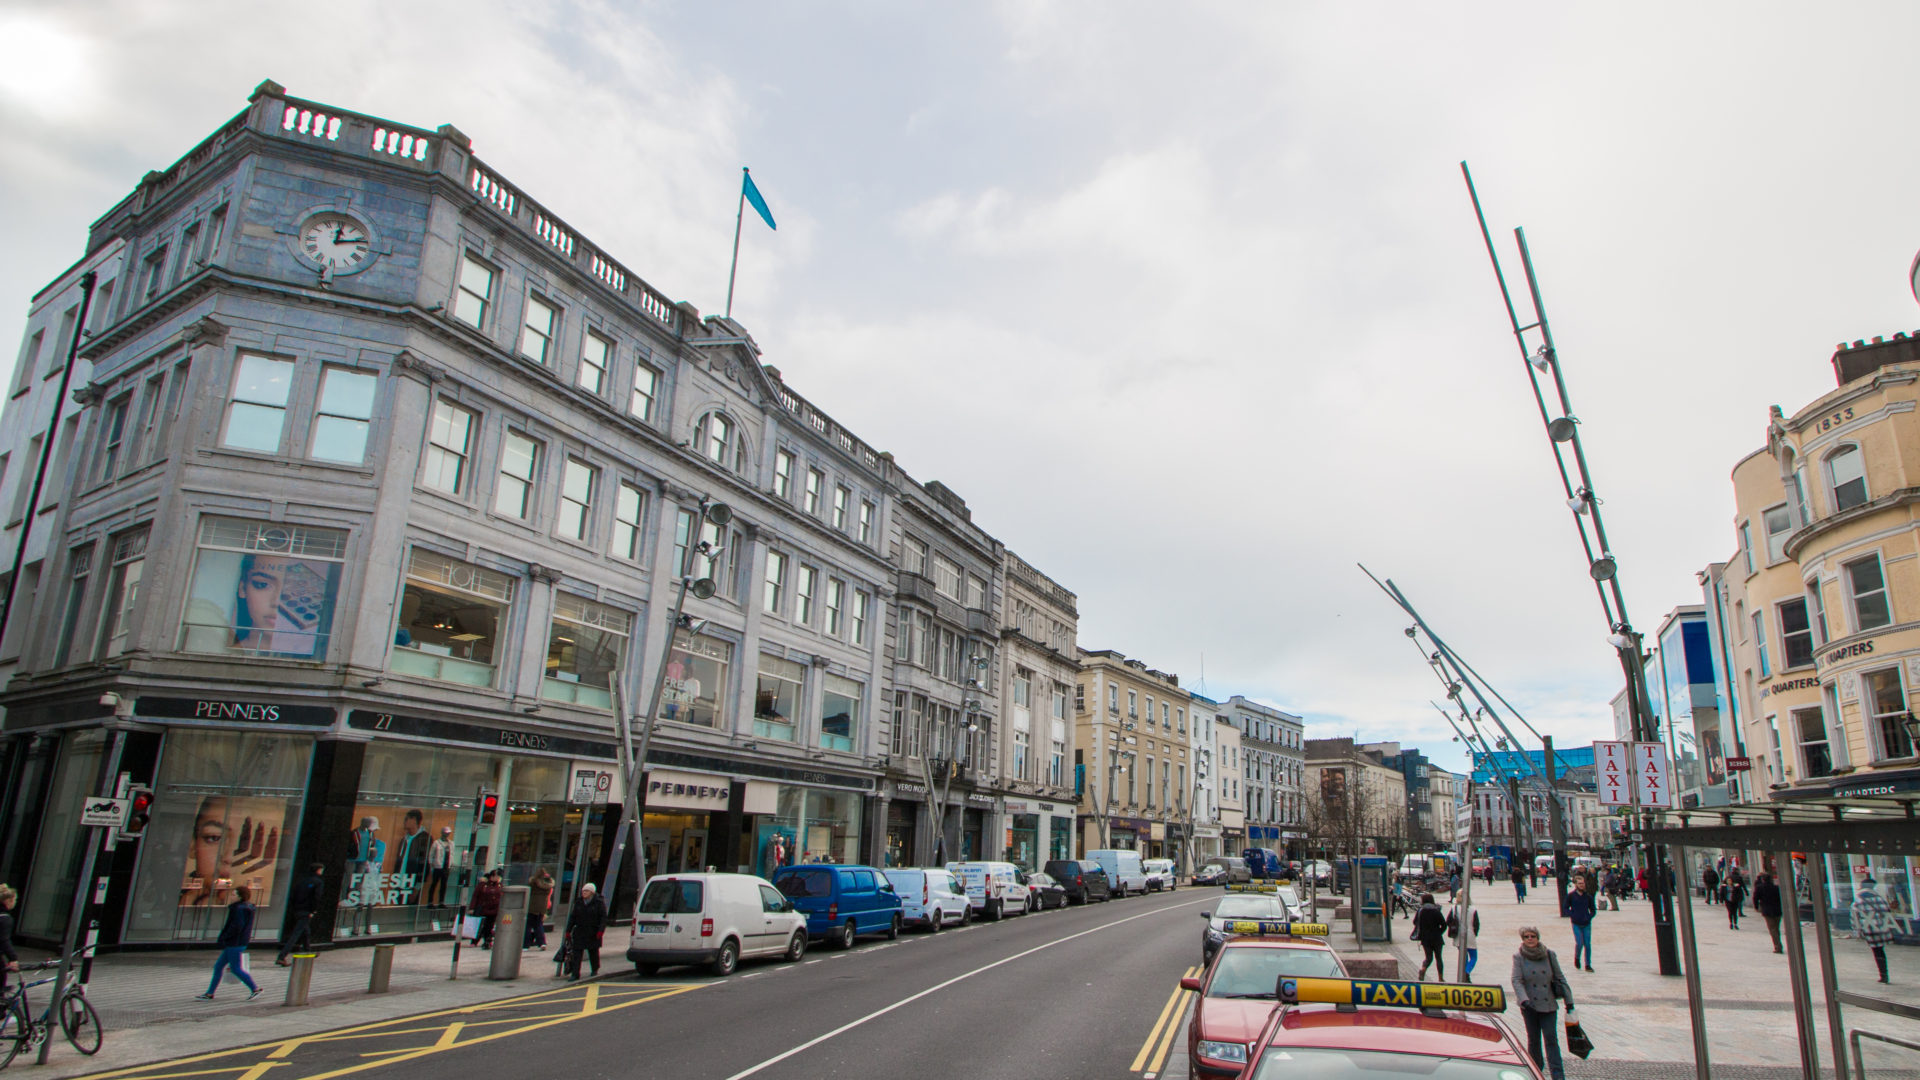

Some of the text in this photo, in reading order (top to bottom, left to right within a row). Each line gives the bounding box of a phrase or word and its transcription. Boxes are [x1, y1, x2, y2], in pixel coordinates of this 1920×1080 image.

[1816, 407, 1854, 434] 1833
[1826, 640, 1874, 666] QUARTERS
[1771, 677, 1820, 695] QUARTERS
[195, 701, 280, 721] PENNEYS
[374, 713, 394, 731] 27
[501, 730, 548, 749] PENNEYS
[1603, 744, 1621, 802] TAXI
[1643, 745, 1660, 803] TAXI
[650, 781, 729, 799] PENNEYS
[897, 783, 913, 792] VERO
[1038, 802, 1054, 812] TIGER
[1264, 923, 1287, 934] TAXI
[1301, 924, 1326, 934] 11064
[1355, 982, 1417, 1005] TAXI
[1440, 987, 1494, 1008] 10629
